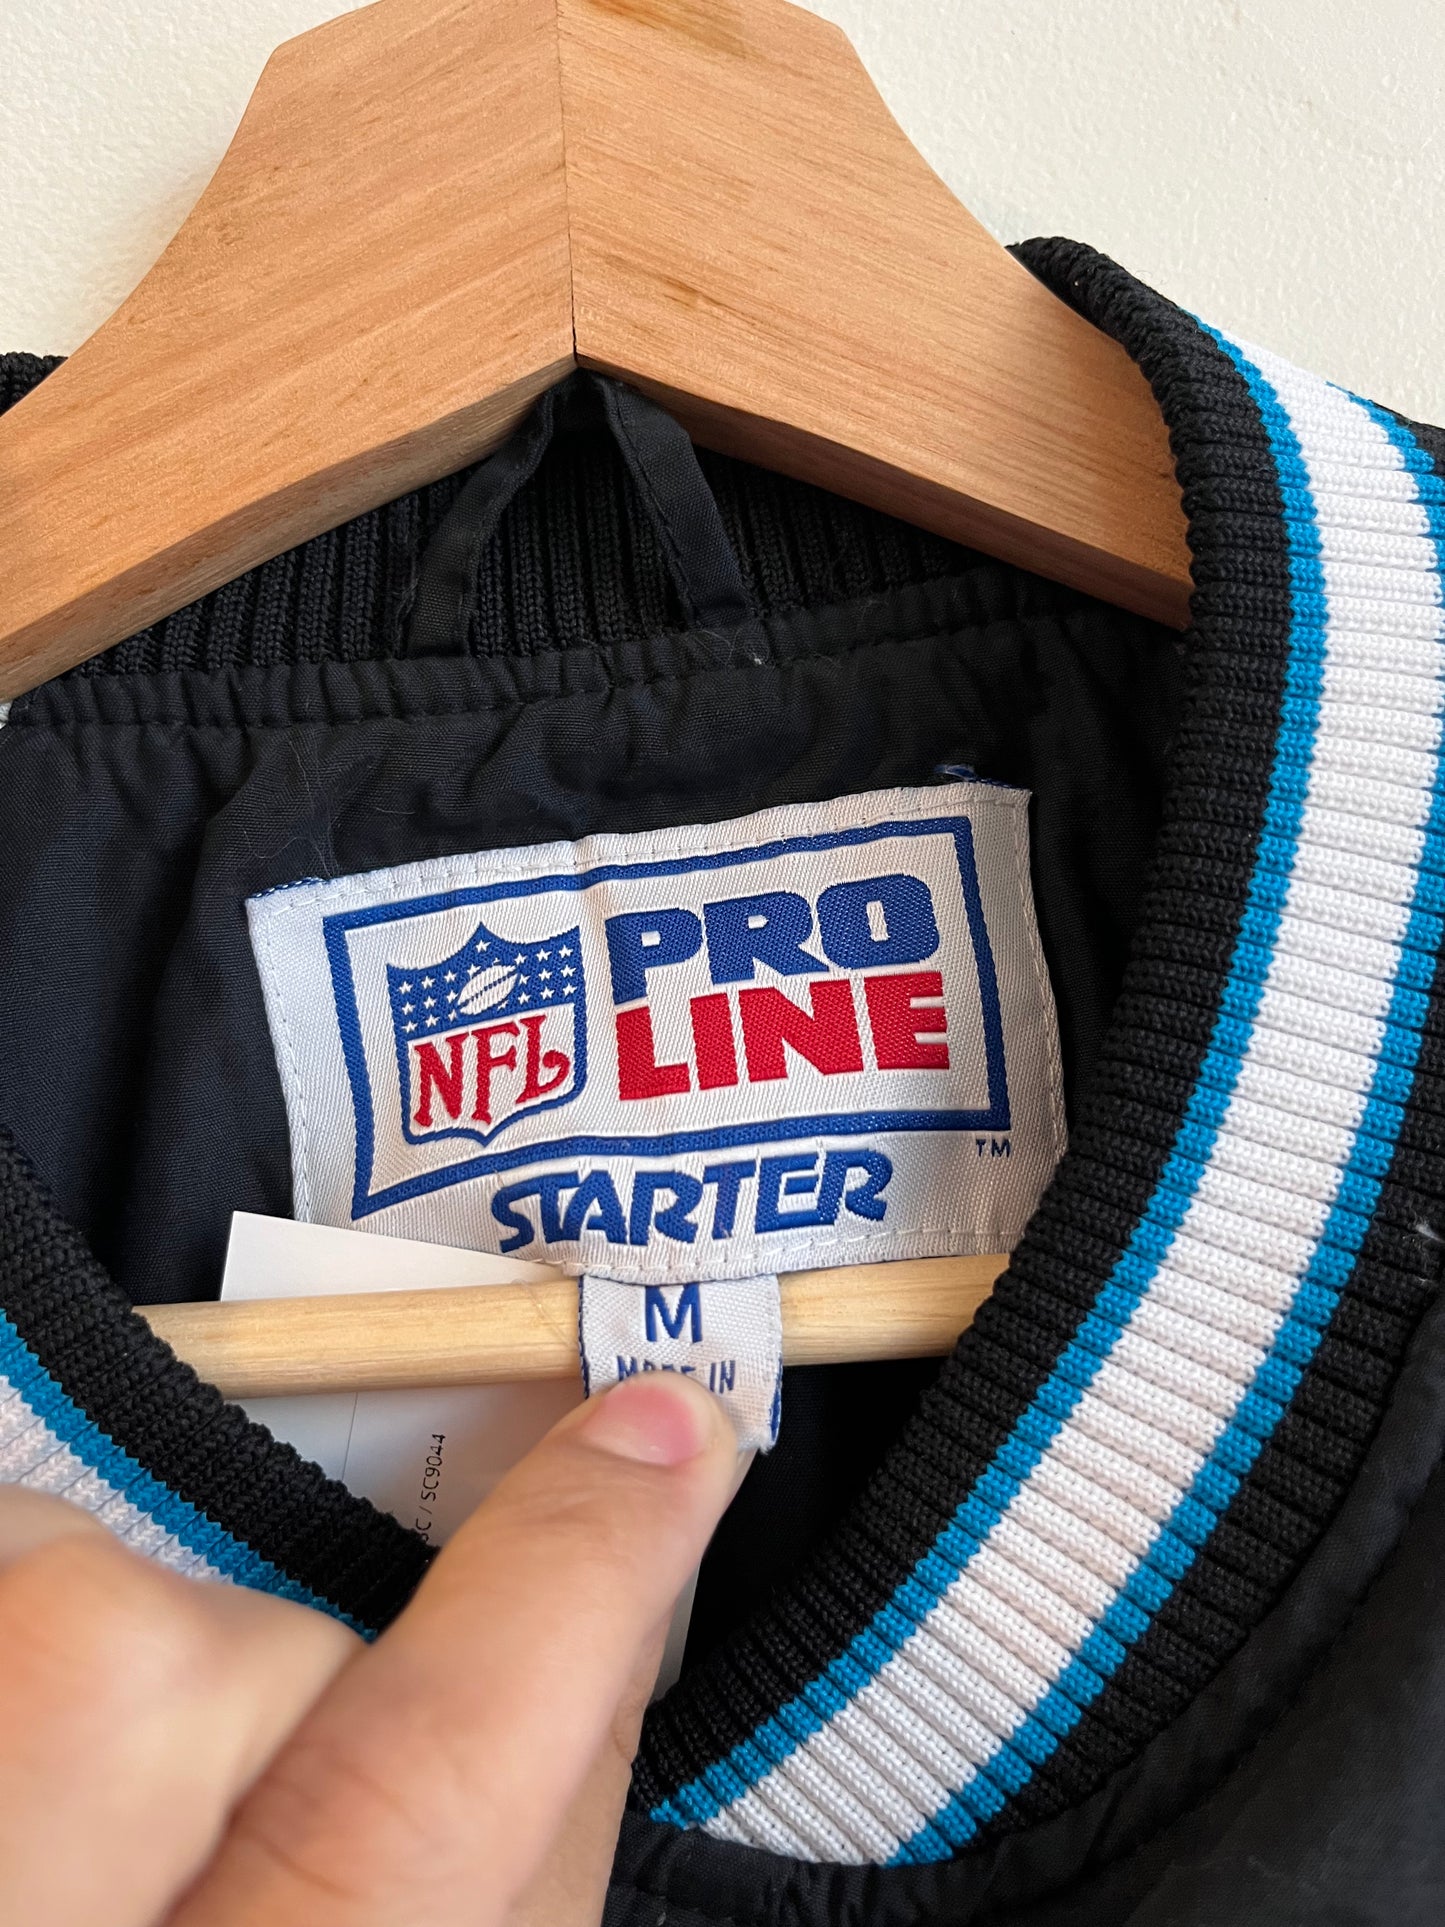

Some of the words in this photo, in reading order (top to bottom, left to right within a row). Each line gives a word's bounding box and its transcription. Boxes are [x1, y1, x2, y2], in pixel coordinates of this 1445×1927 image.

[606, 873, 940, 1002] PRO
[411, 1015, 570, 1127] NFL
[616, 972, 950, 1101] LINE
[975, 1138, 1012, 1158] TM
[491, 1150, 893, 1253] STARTER
[644, 1282, 703, 1343] M
[709, 1360, 736, 1394] IN
[420, 1432, 446, 1502] SC9044
